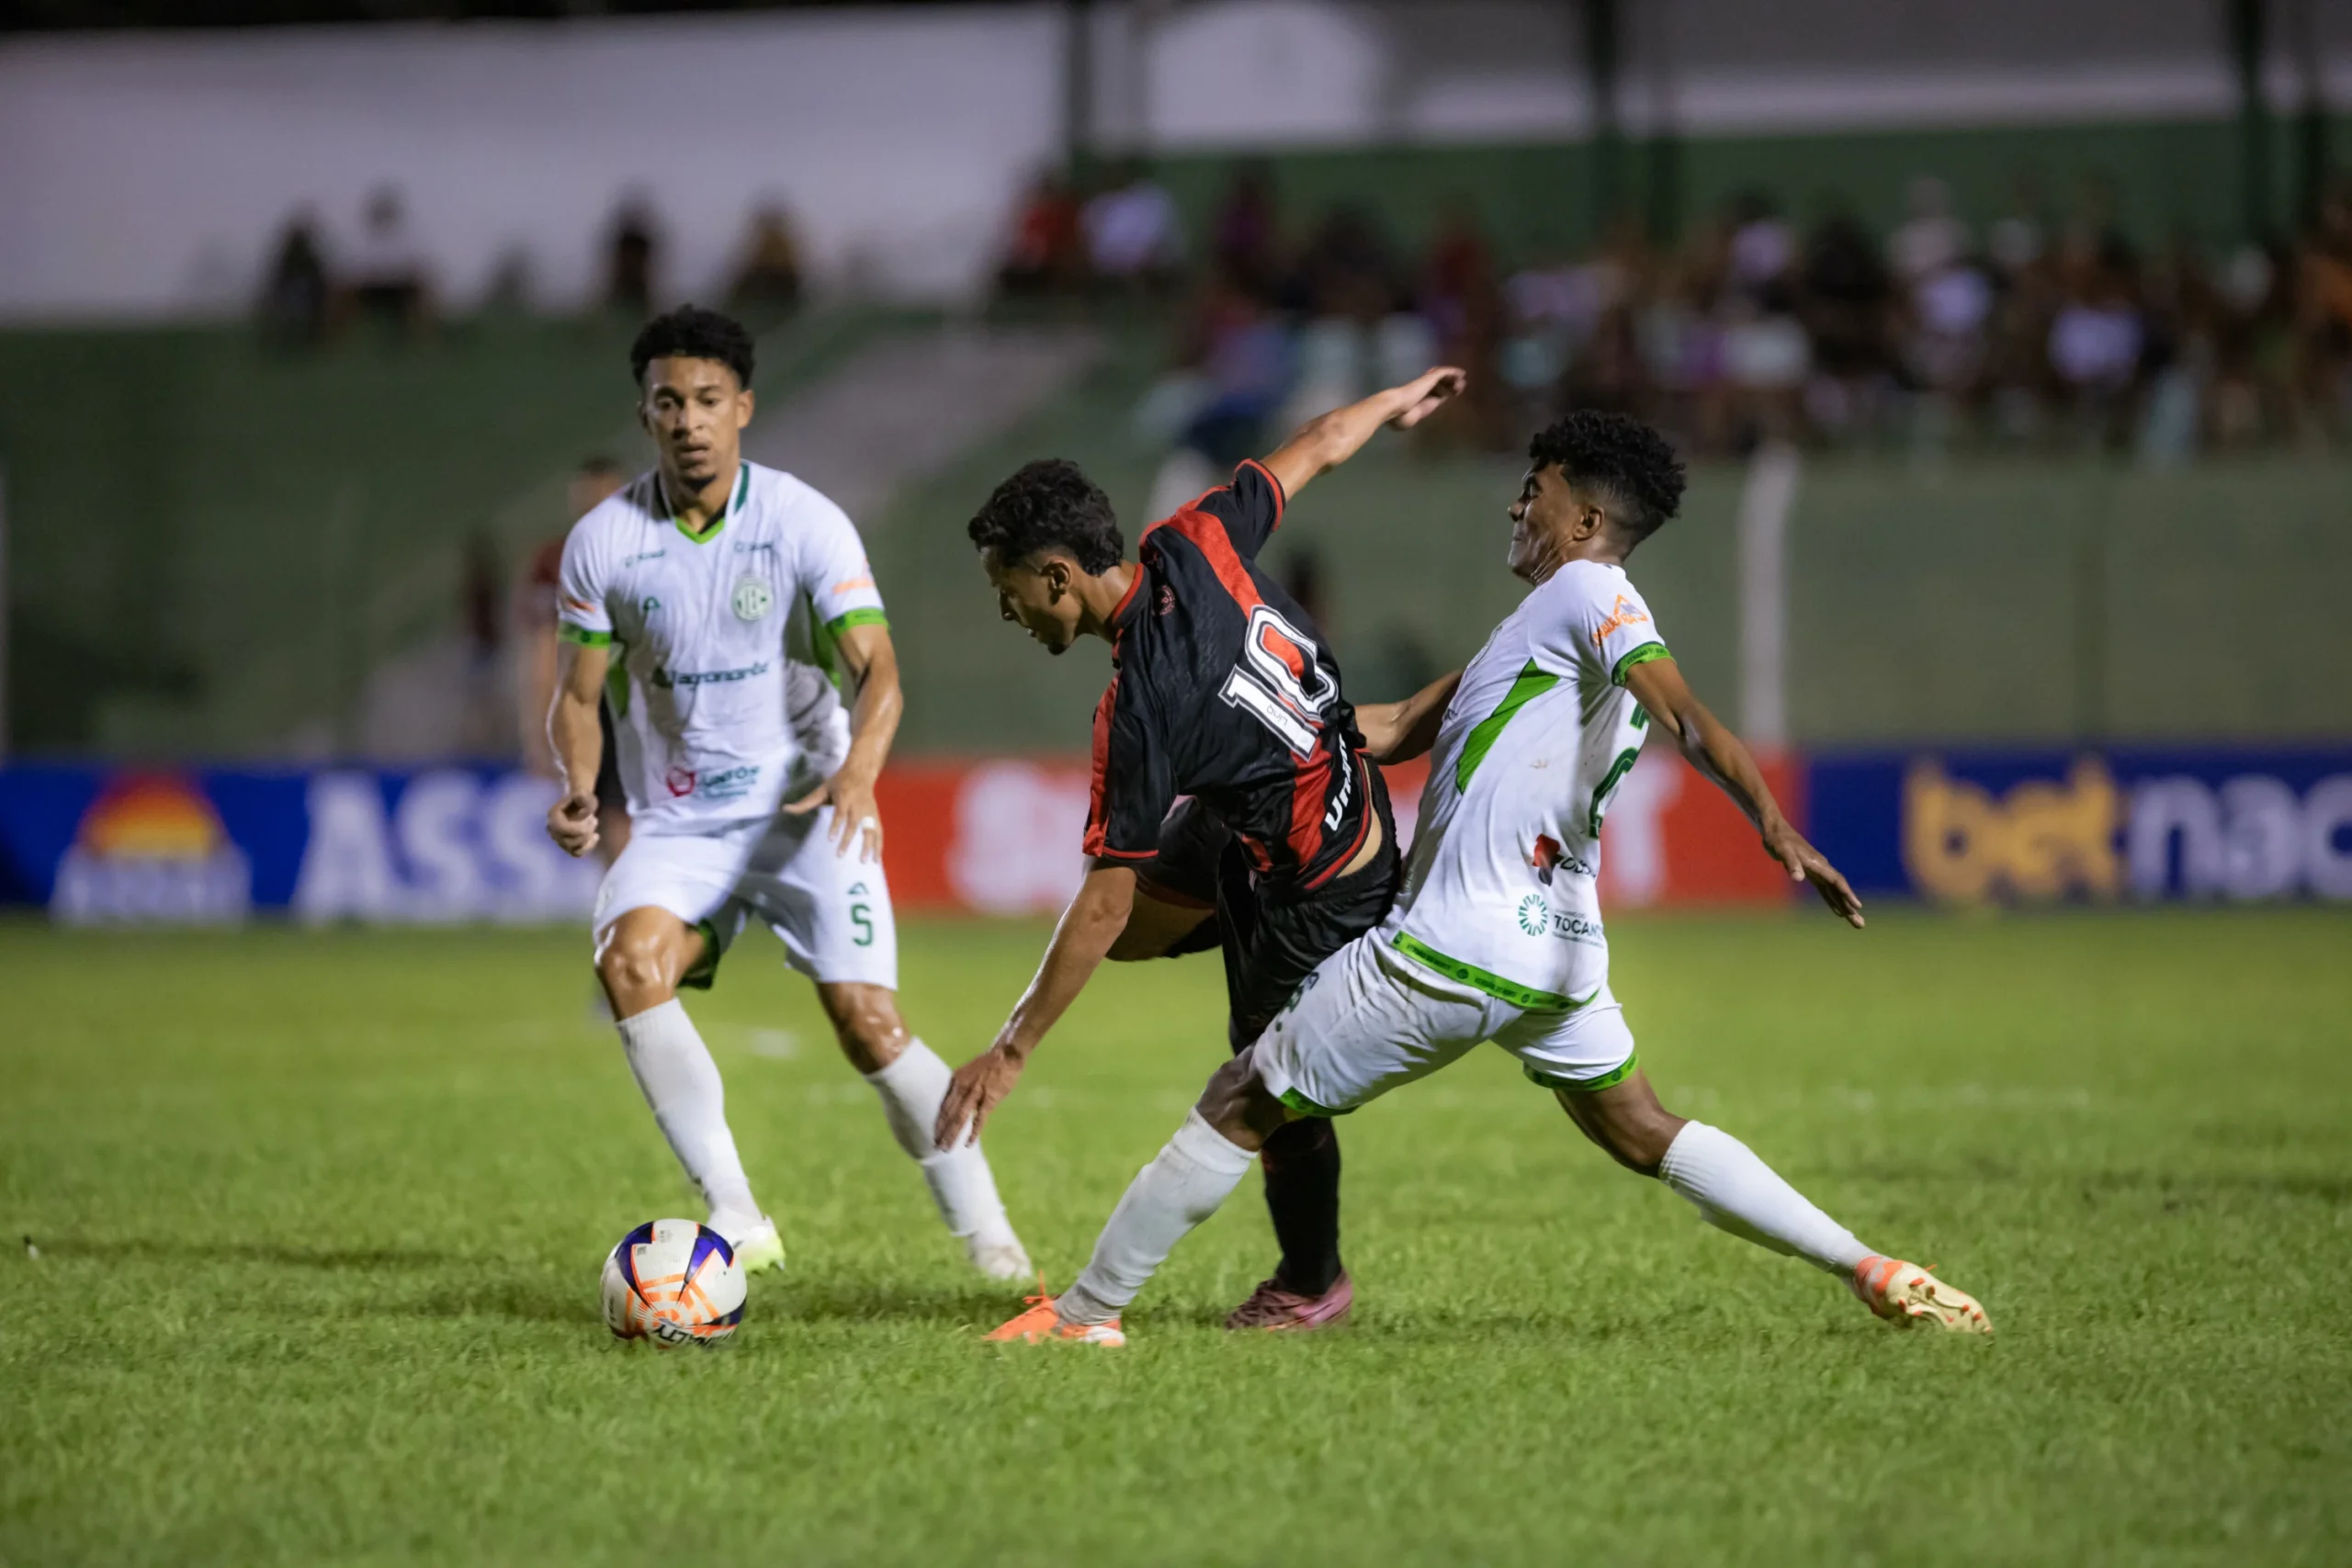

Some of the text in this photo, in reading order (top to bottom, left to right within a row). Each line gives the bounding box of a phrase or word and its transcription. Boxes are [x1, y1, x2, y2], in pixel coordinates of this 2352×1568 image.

[1217, 604, 1339, 762] 10
[292, 768, 602, 924] ASS
[850, 902, 875, 948] 5
